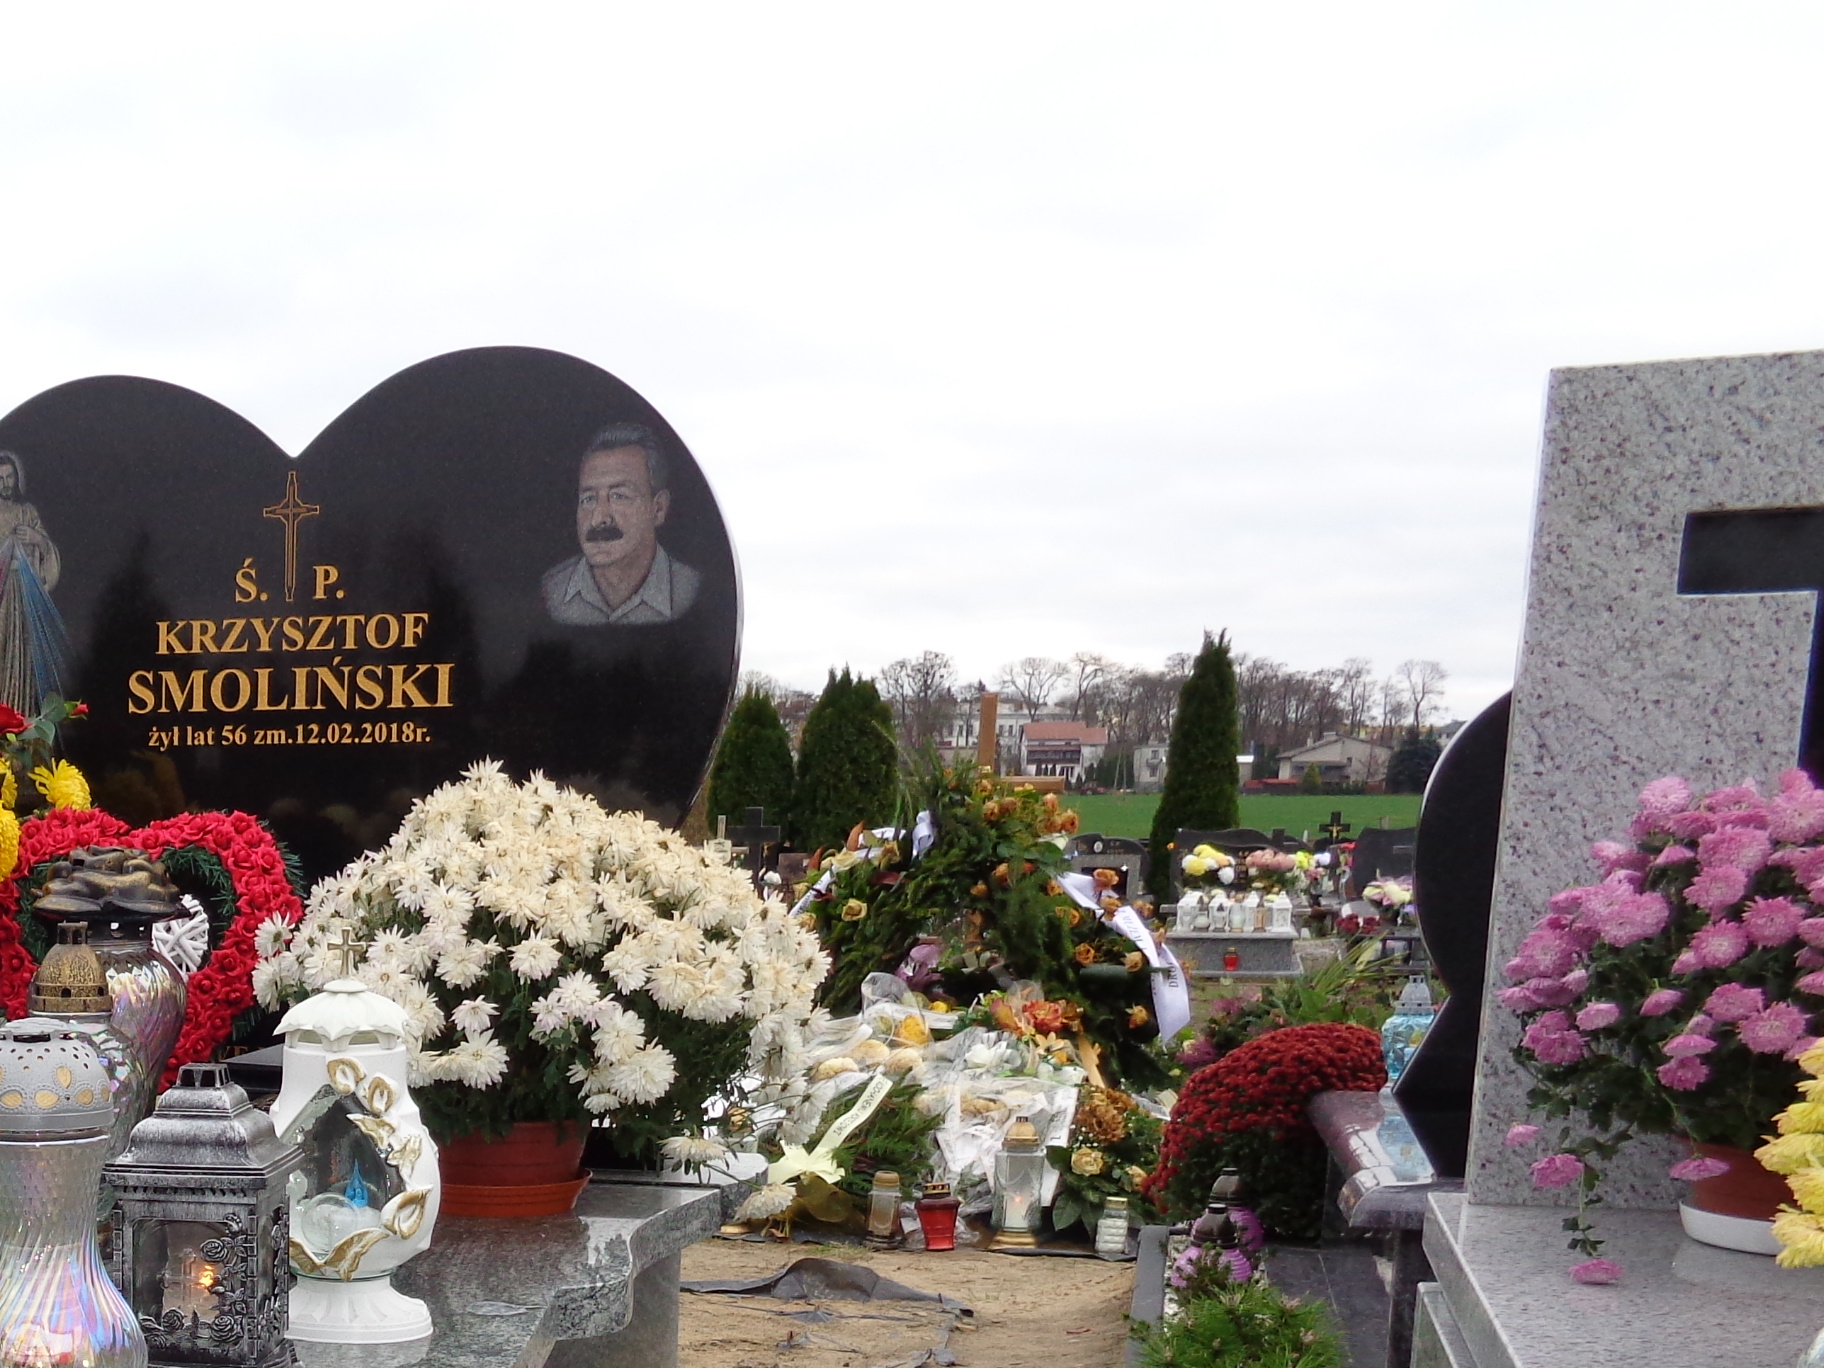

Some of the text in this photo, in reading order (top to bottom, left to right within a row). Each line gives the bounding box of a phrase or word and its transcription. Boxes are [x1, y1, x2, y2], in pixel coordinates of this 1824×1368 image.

[234, 557, 345, 603] Ś. P.
[155, 611, 429, 655] KRZYSZTOF
[128, 656, 455, 714] SMOLIŃSKI
[148, 720, 432, 752] żył lat 56 zm.12.02.2018r.
